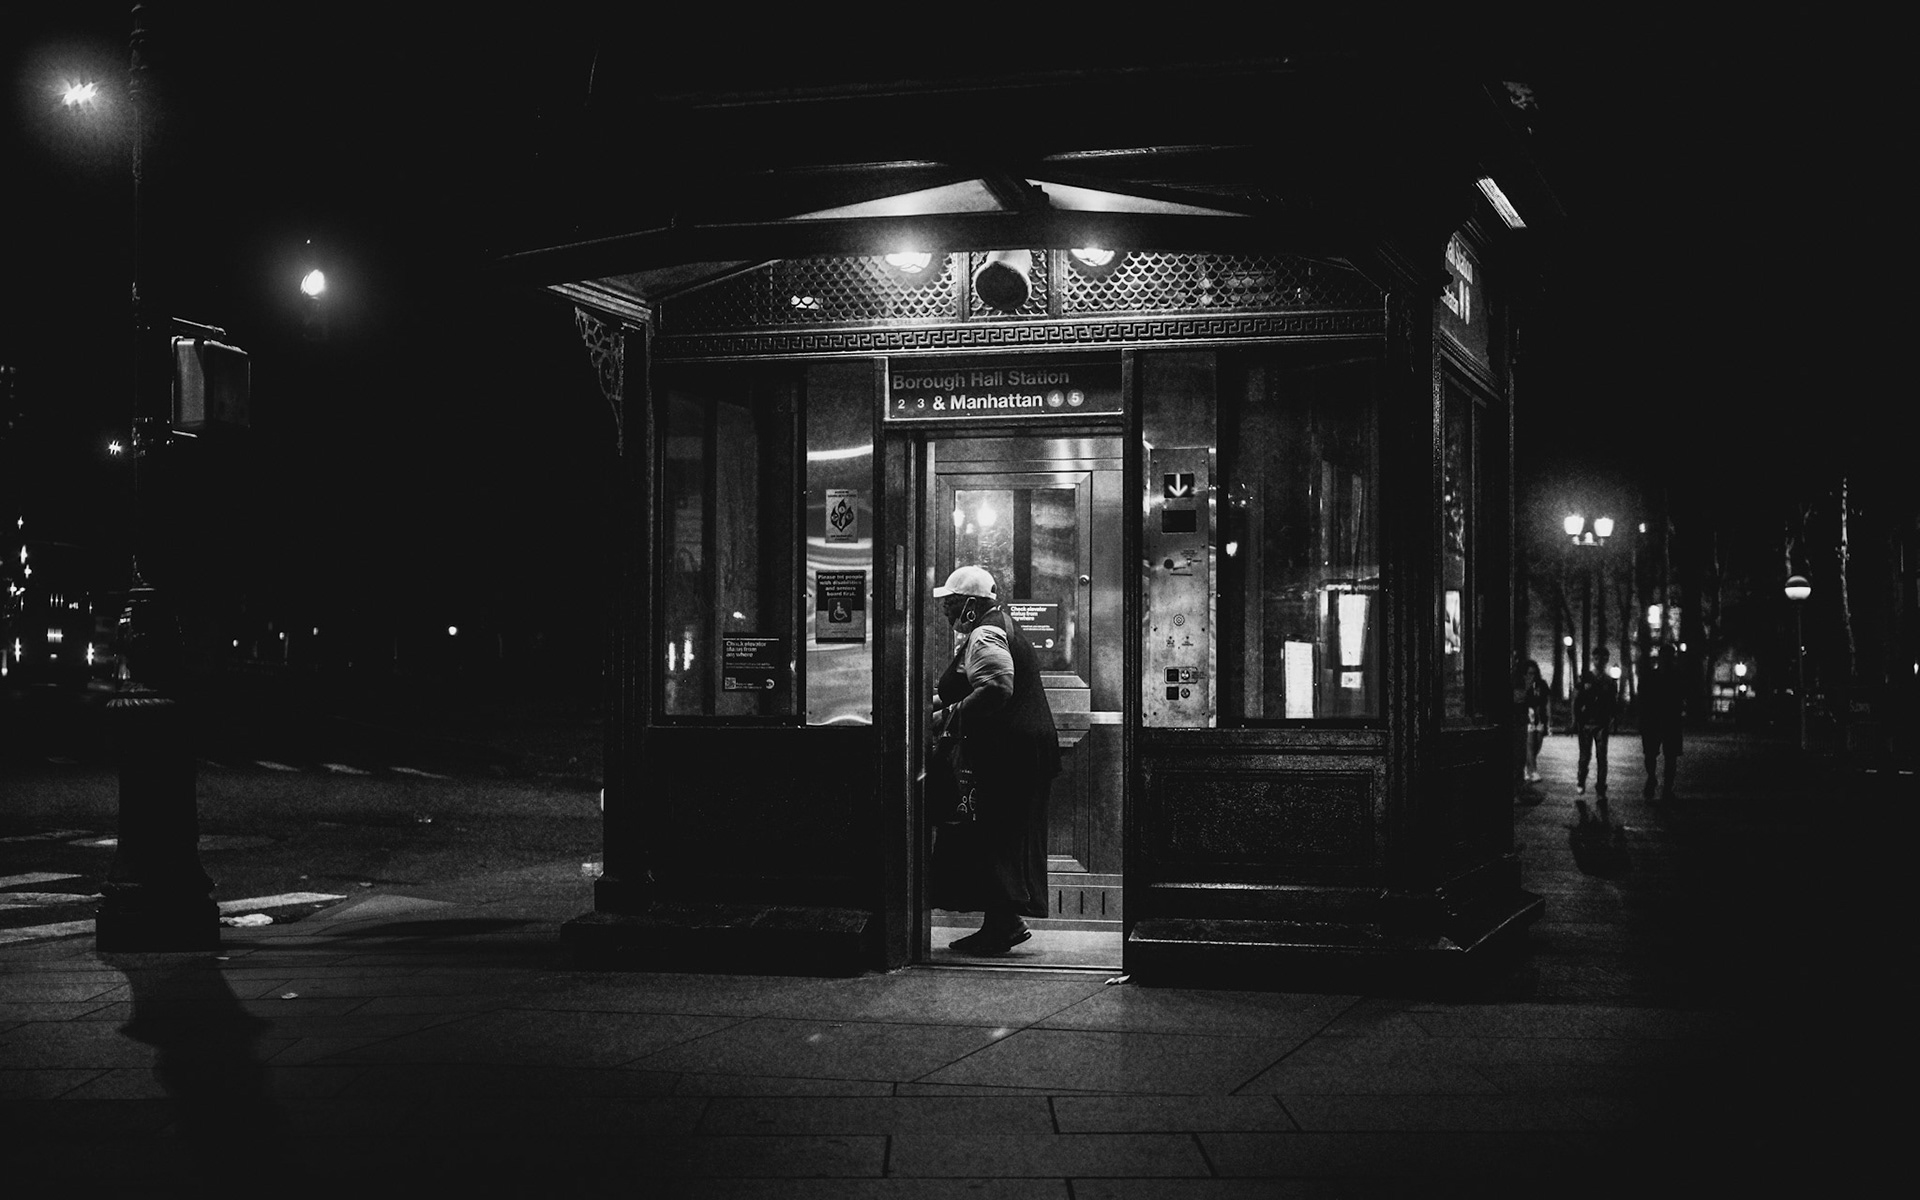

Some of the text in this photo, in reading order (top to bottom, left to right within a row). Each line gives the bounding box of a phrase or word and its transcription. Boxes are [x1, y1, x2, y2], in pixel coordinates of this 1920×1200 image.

[892, 370, 1070, 392] Borough Hall Station
[897, 398, 906, 410] 2
[917, 397, 926, 409] 3
[932, 395, 947, 411] &
[950, 393, 1043, 410] Manhattan
